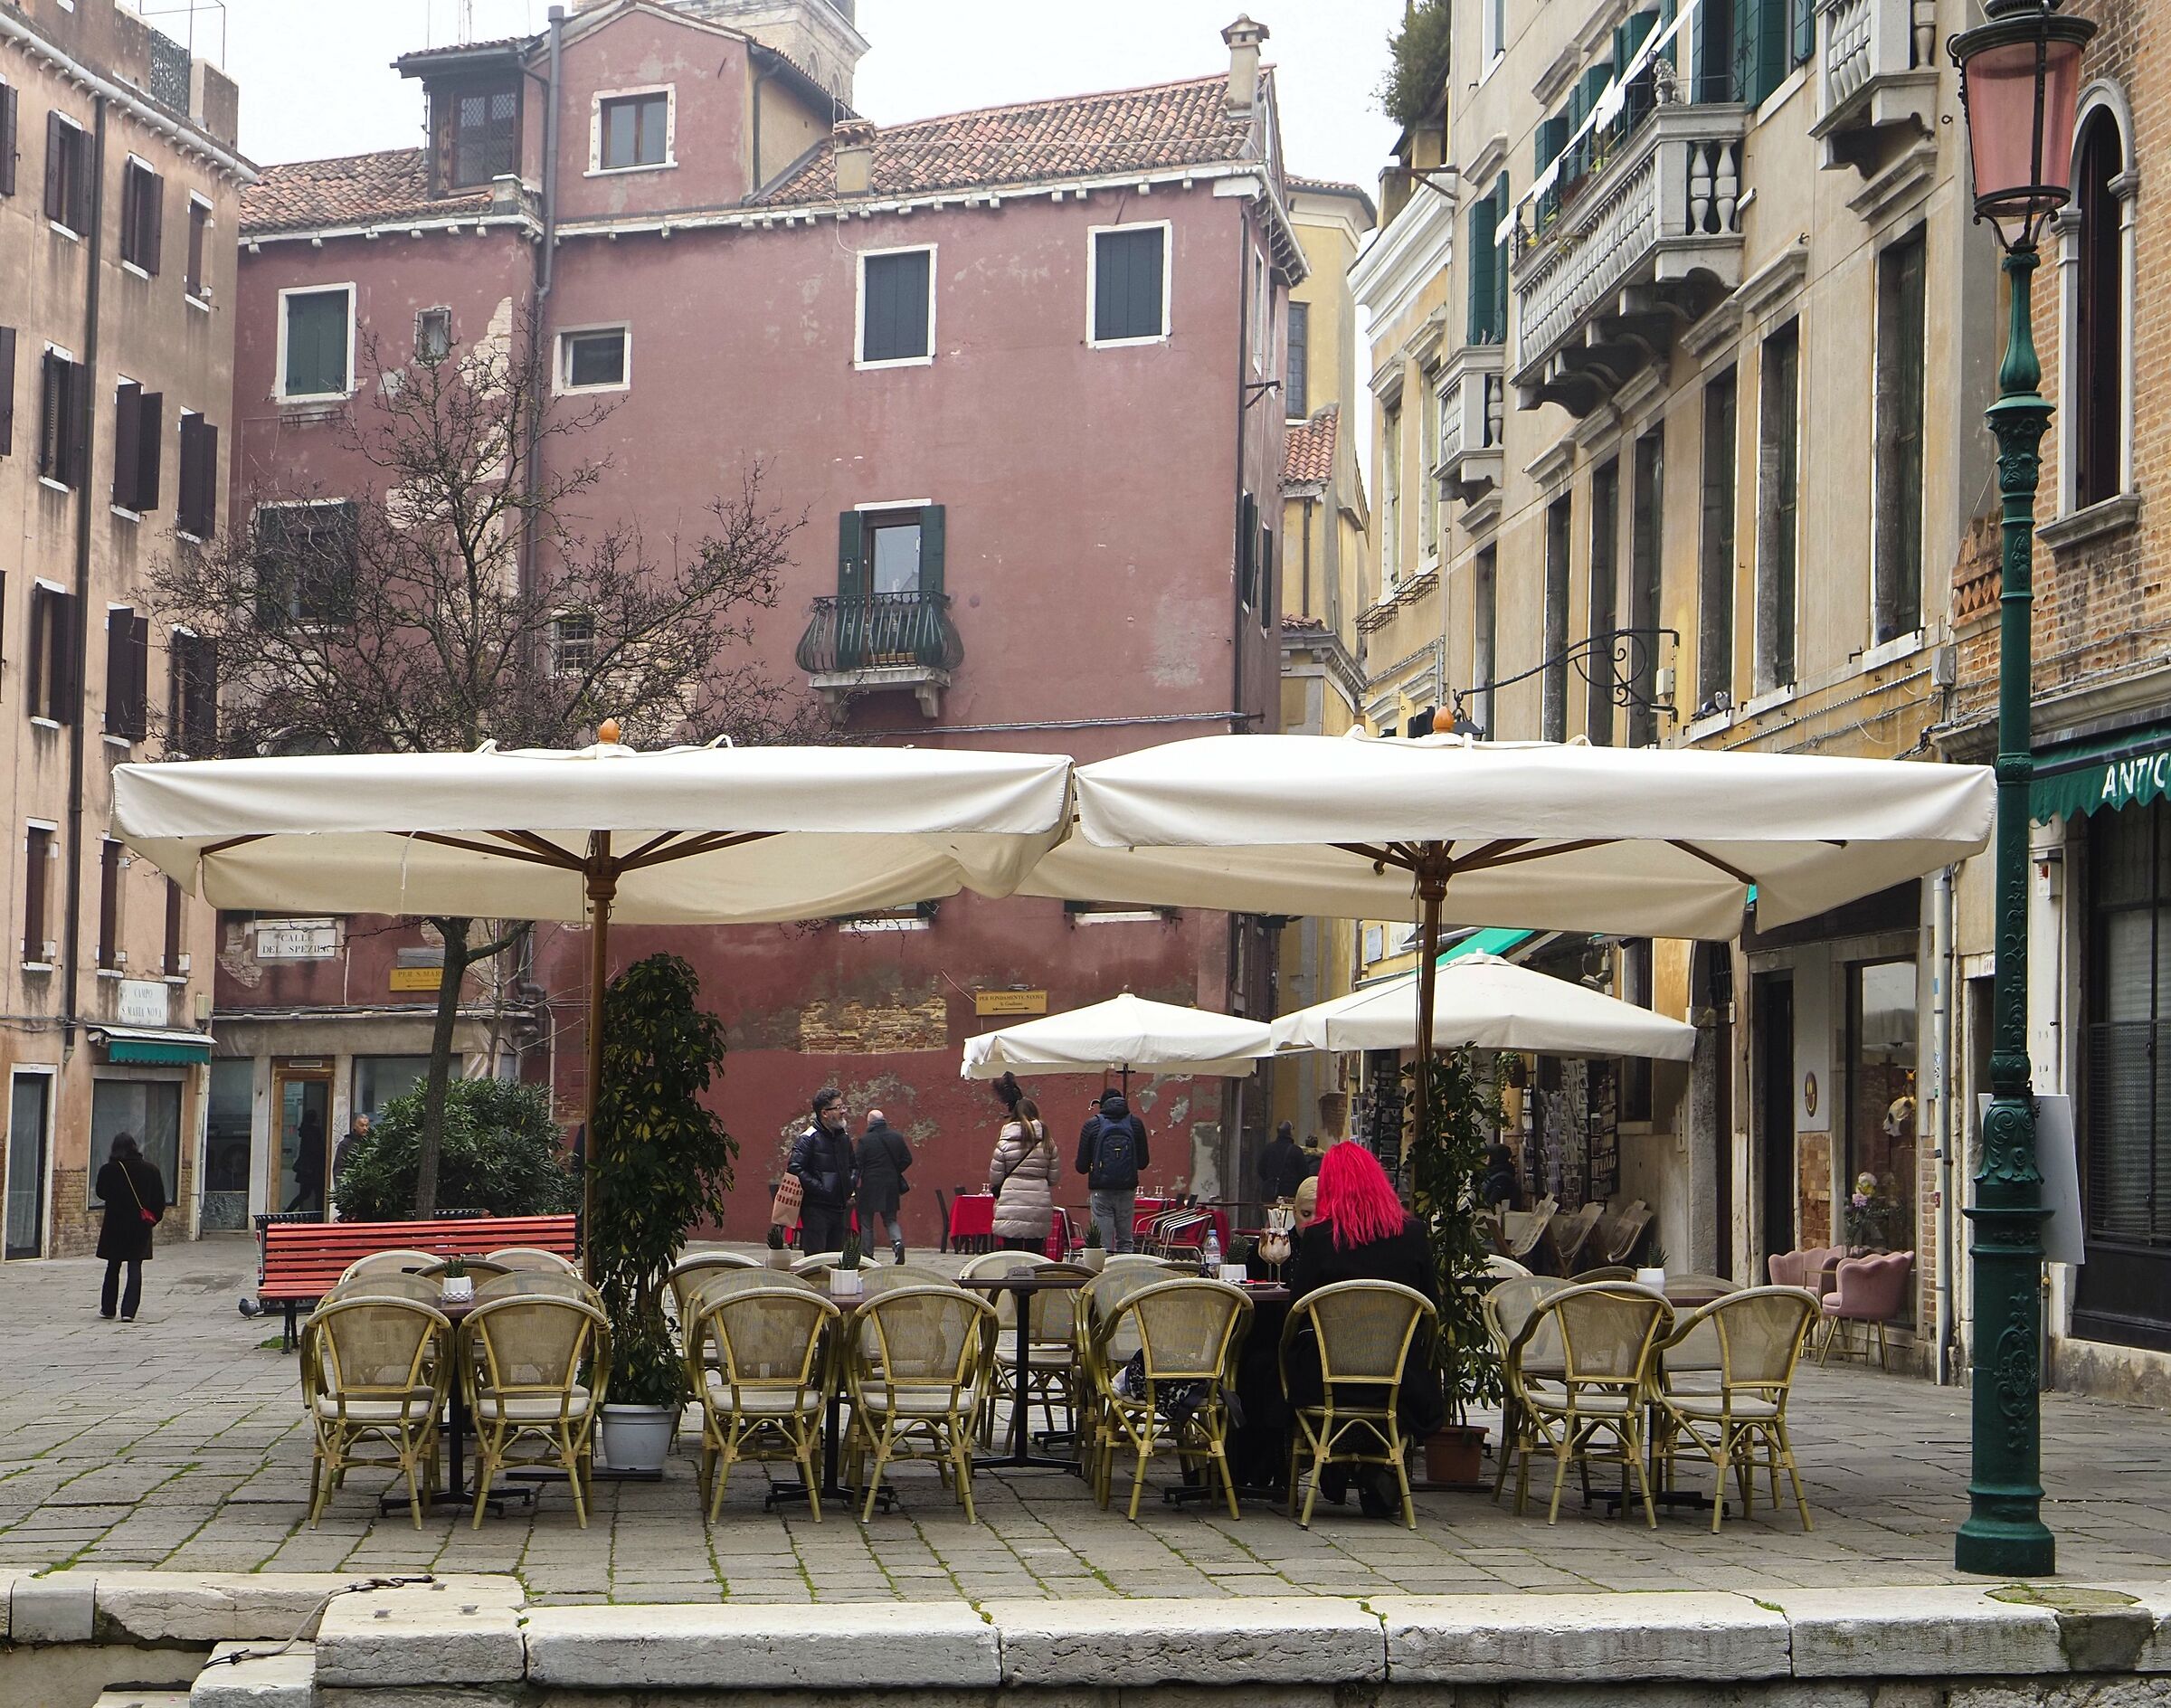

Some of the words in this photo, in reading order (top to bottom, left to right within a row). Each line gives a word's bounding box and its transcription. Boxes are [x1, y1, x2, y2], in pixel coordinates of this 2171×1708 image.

[2101, 753, 2171, 799] ANTIC
[262, 945, 281, 954] DEL
[134, 988, 152, 998] CAMPO
[128, 1006, 145, 1018] MARIA
